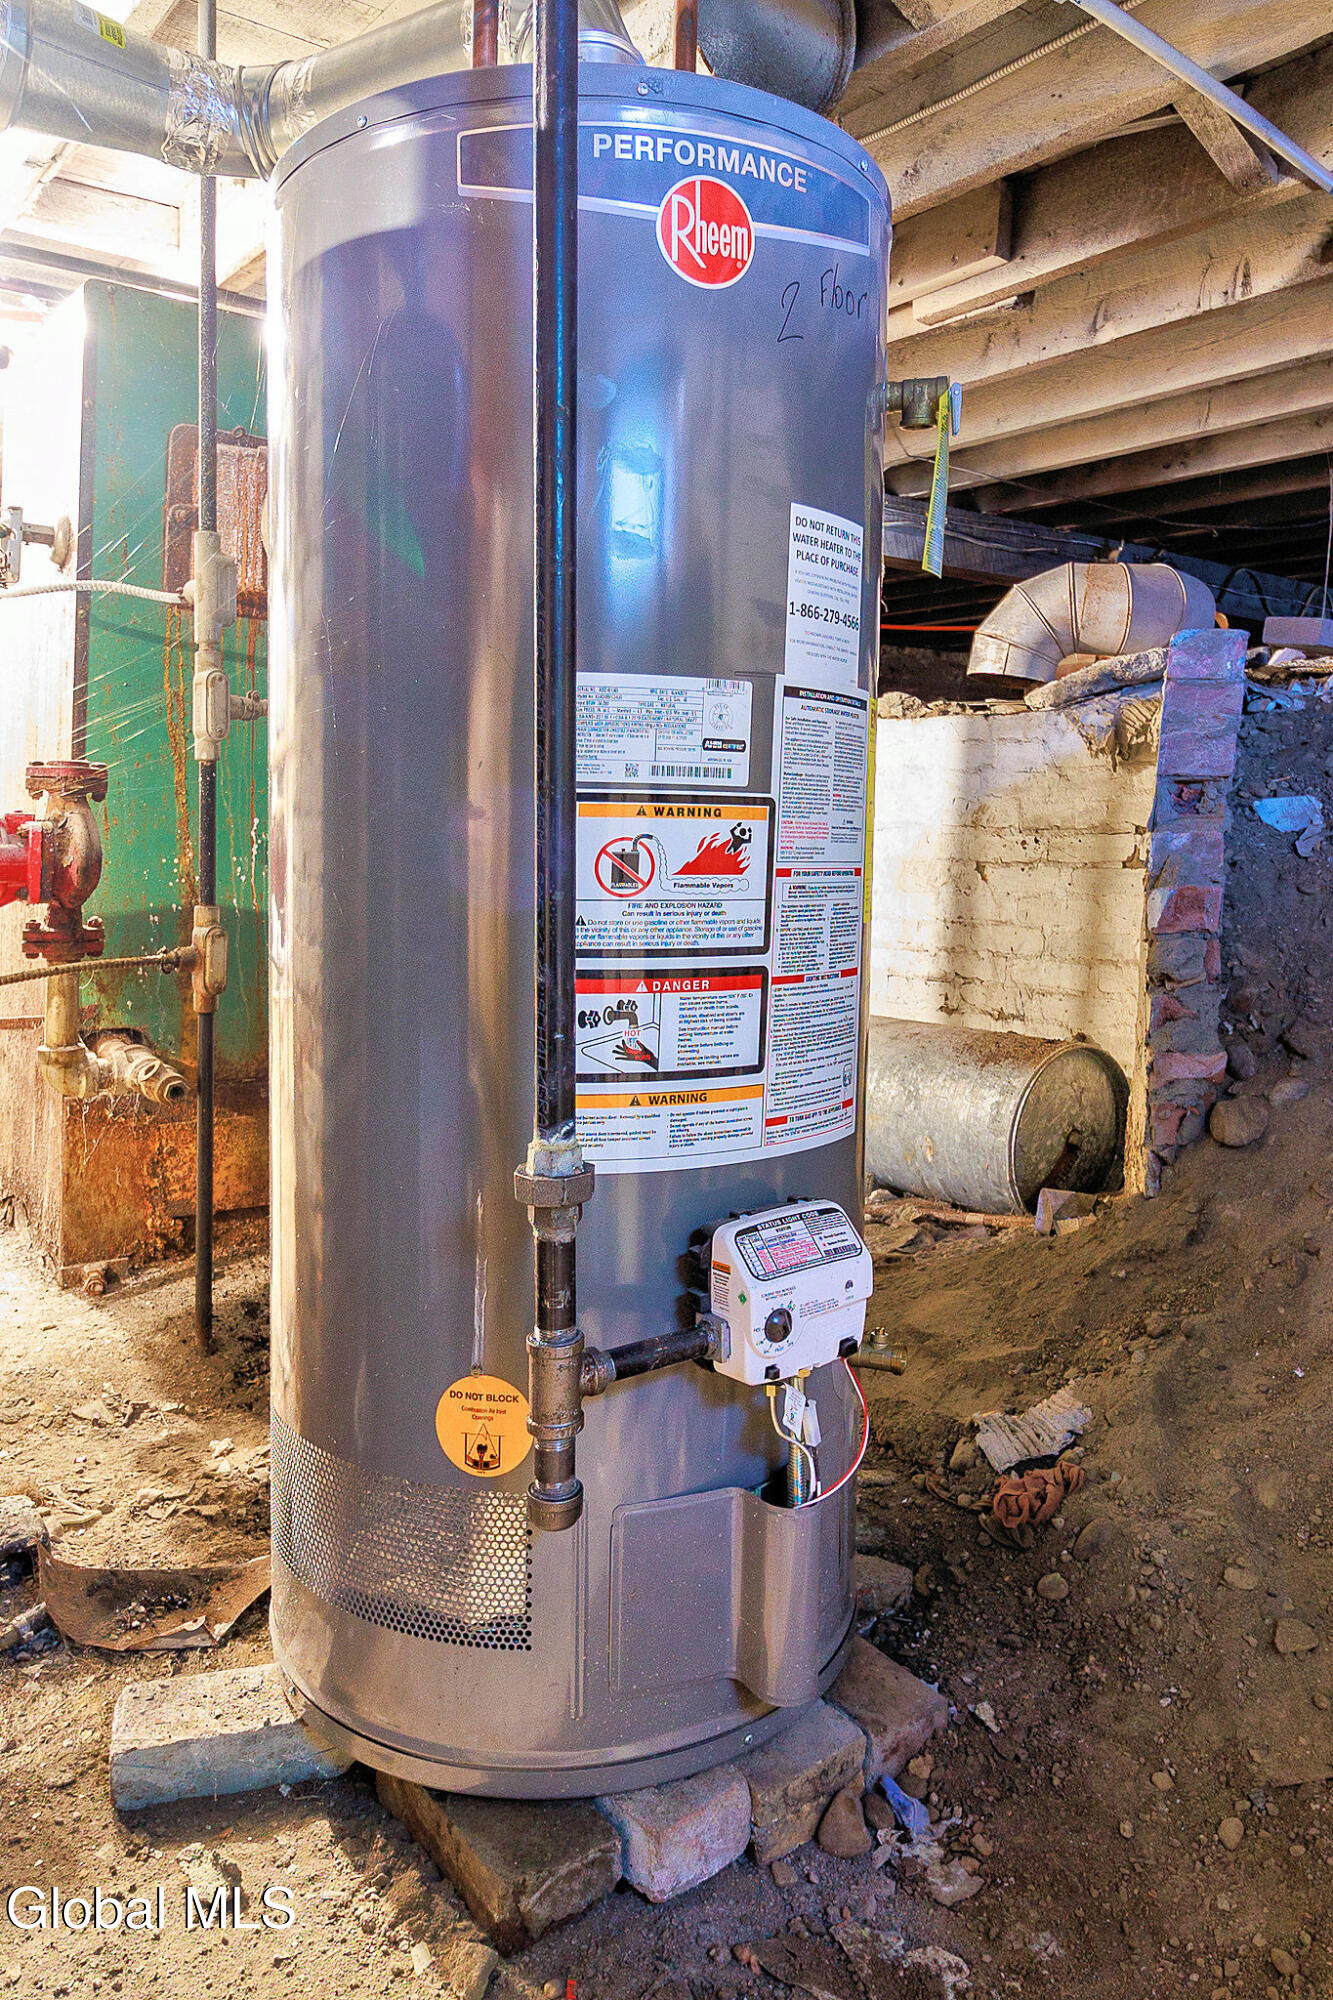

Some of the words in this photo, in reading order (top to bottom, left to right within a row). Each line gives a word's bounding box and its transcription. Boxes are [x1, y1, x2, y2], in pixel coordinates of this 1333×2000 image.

[593, 133, 808, 193] PERFORMANCE
[671, 180, 748, 268] Rheem
[777, 281, 803, 344] 2
[819, 263, 869, 319] Floor
[795, 516, 808, 527] DO
[809, 520, 825, 531] NOT
[825, 523, 850, 542] RETURN
[850, 533, 861, 546] THIS
[792, 531, 819, 548] WATER
[820, 539, 844, 554] HEATER
[844, 545, 852, 558] TO
[852, 548, 861, 562] THE
[796, 549, 819, 564] PLACE
[820, 555, 830, 566] OF
[830, 558, 859, 577] PURCHASE
[789, 601, 860, 631] 1-866-279-4566
[654, 806, 722, 818] WARNING
[686, 910, 702, 918] injury
[644, 918, 668, 926] gasoline
[652, 980, 710, 992] DANGER
[624, 1029, 641, 1037] HOT
[648, 1092, 708, 1105] WARNING
[756, 1219, 782, 1231] STATUS
[781, 1214, 801, 1224] LIGHT
[449, 1390, 463, 1399] DO
[465, 1391, 483, 1400] NOT
[485, 1393, 519, 1403] BLOCK
[471, 1413, 494, 1422] Openings
